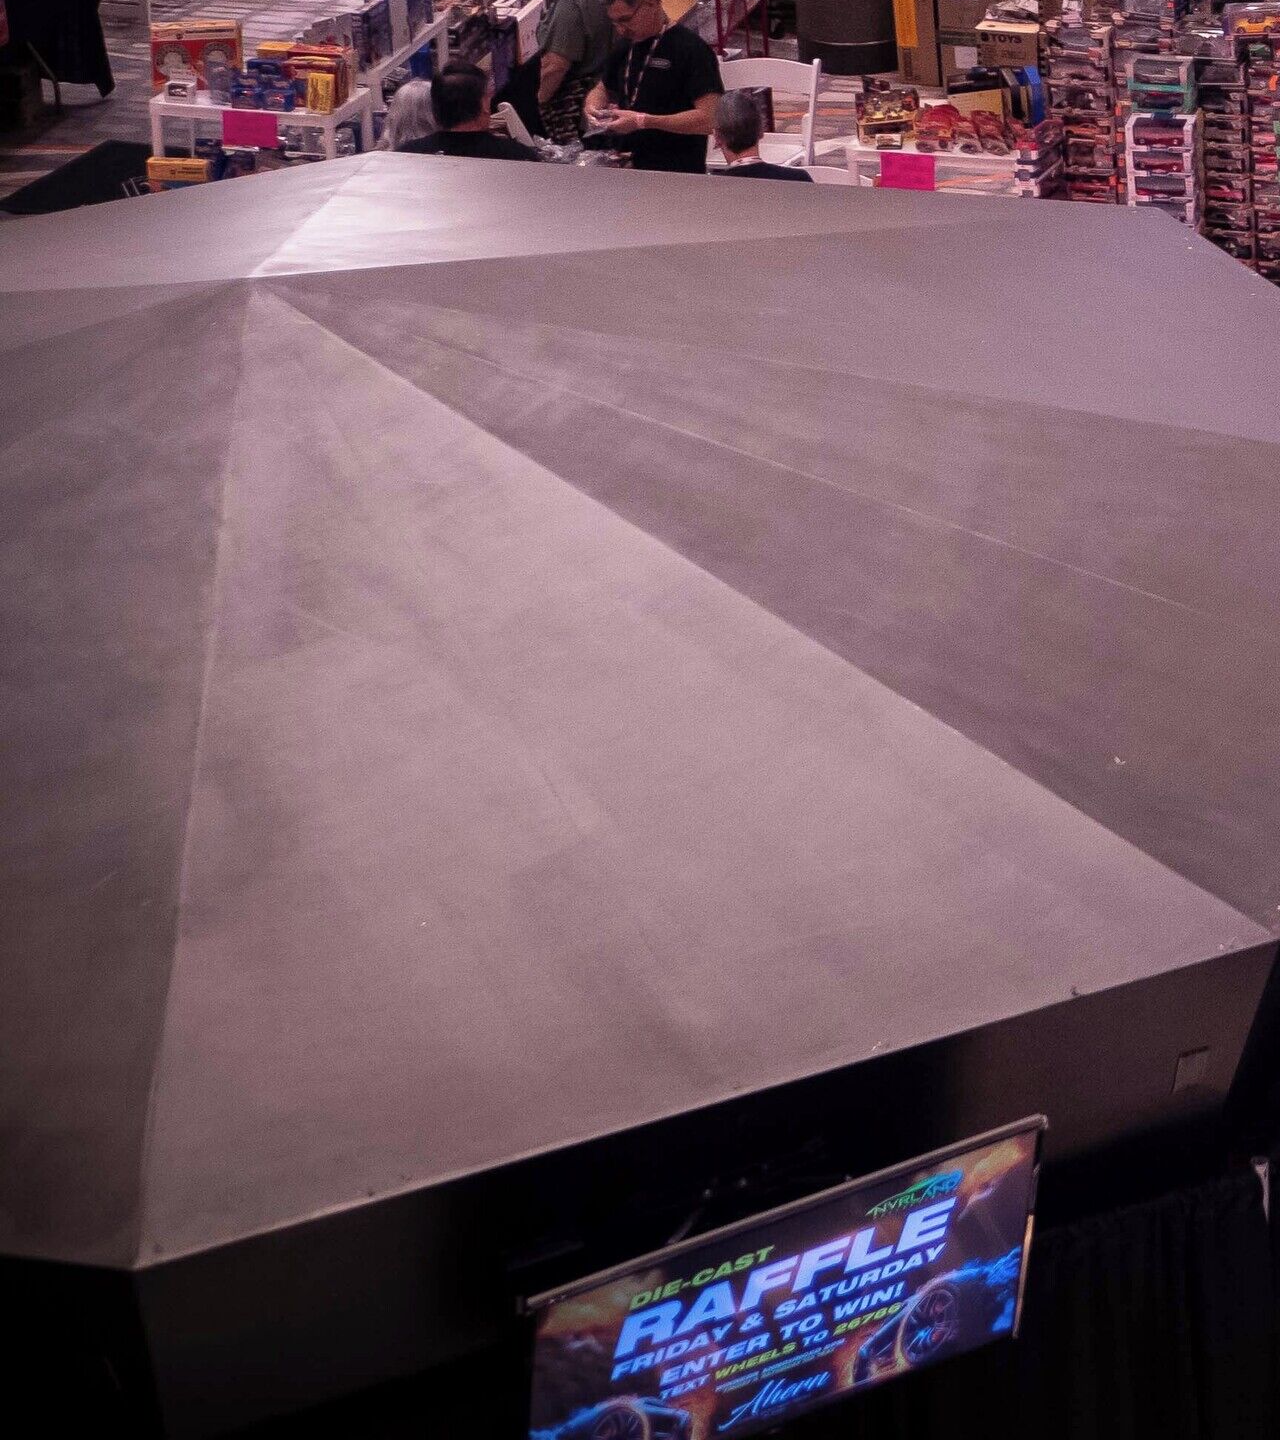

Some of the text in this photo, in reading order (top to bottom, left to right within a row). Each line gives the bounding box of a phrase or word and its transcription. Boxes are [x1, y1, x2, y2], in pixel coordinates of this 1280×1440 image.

[991, 34, 1022, 44] TOYS
[610, 1321, 733, 1383] FRIDAY
[739, 1312, 765, 1333] &
[773, 1242, 947, 1322] SATURDAY
[613, 1197, 956, 1360] RAFFLE
[629, 1245, 775, 1309] DIE-CAST
[659, 1331, 772, 1387] ENTER
[779, 1312, 824, 1342] TO
[833, 1281, 906, 1323] WIN!
[660, 1373, 711, 1401] TEXT
[714, 1341, 798, 1381] WHEELS
[802, 1330, 829, 1348] TO
